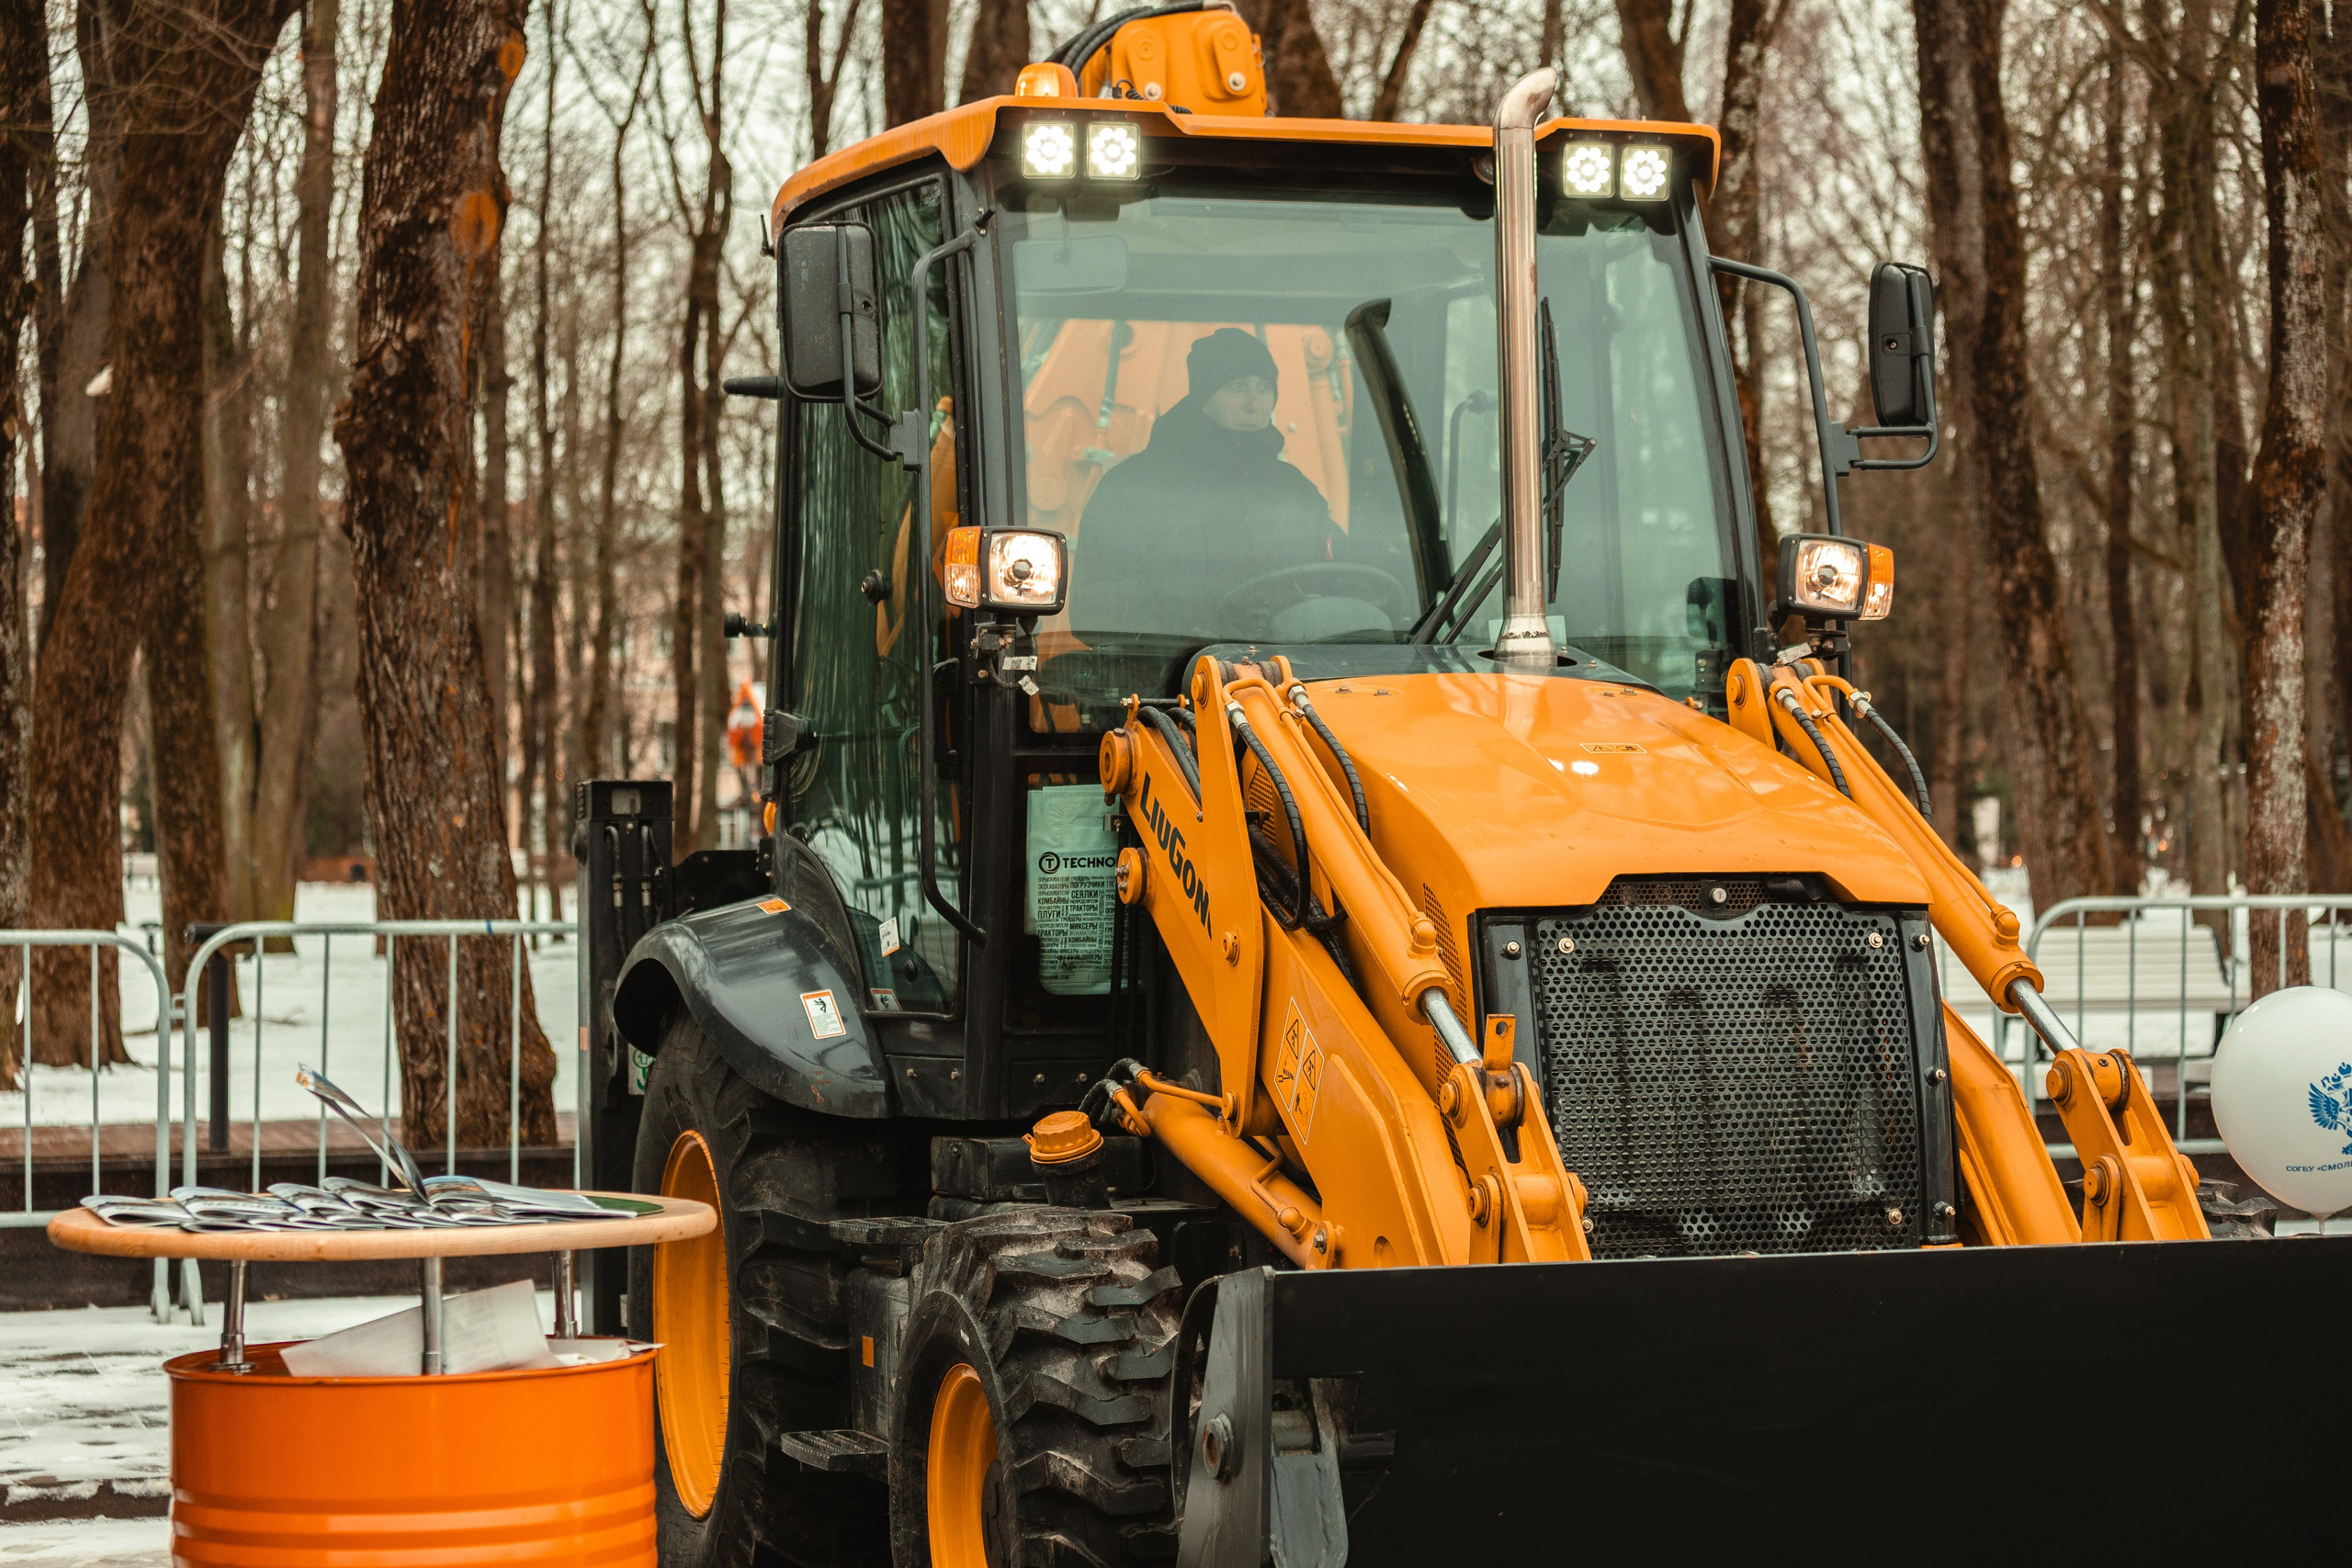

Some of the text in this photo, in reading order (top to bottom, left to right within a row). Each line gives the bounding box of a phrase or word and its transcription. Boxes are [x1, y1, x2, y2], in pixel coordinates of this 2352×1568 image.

[1140, 771, 1212, 941] LIUGON
[1063, 857, 1117, 869] TECHNO
[1070, 890, 1099, 898] СЕЯЛКИ
[1037, 897, 1069, 905] КОМБАЙНЫ
[1037, 910, 1061, 919] ПЛУГИ
[1069, 922, 1098, 931] МИКСЕРЫ
[1036, 929, 1069, 937] ТРАКТОРЫ
